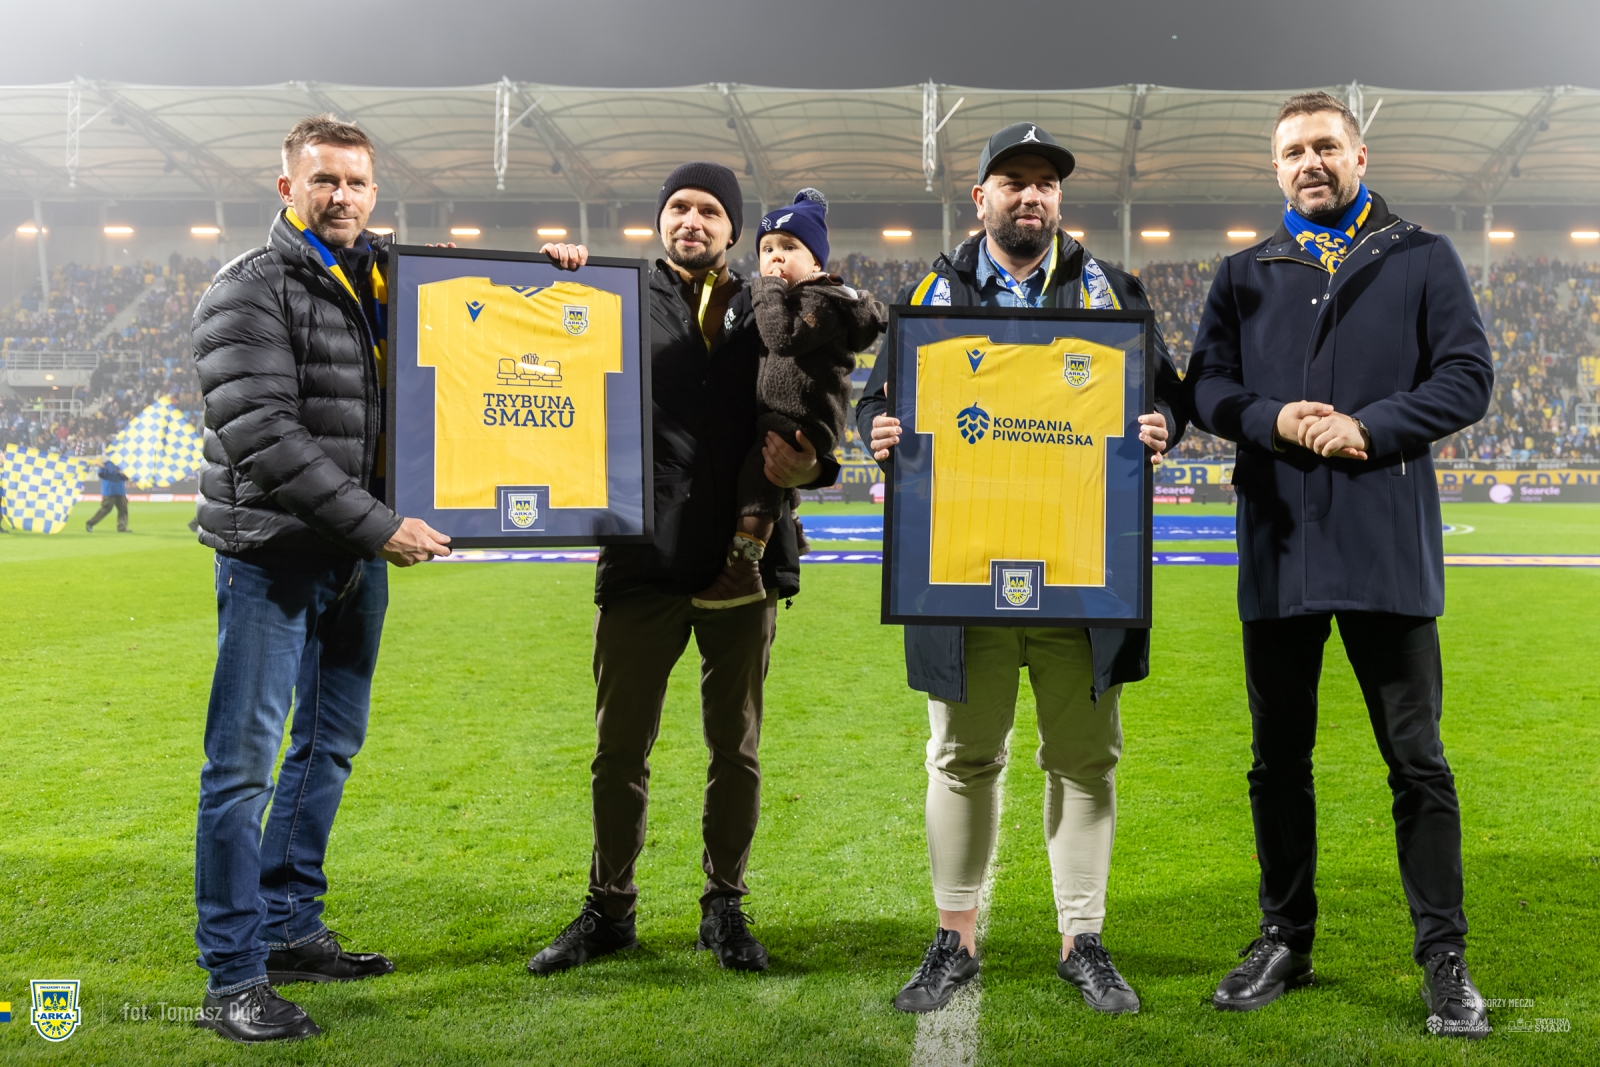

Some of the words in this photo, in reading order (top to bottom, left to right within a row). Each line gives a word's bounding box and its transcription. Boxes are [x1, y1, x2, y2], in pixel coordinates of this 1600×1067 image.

[483, 393, 575, 410] TRYBUNA
[483, 408, 576, 428] SMAKU
[993, 416, 1073, 433] KOMPANIA
[992, 429, 1093, 446] PIWOWARSKA
[1154, 485, 1195, 495] Searcle
[1520, 485, 1561, 496] Searcle
